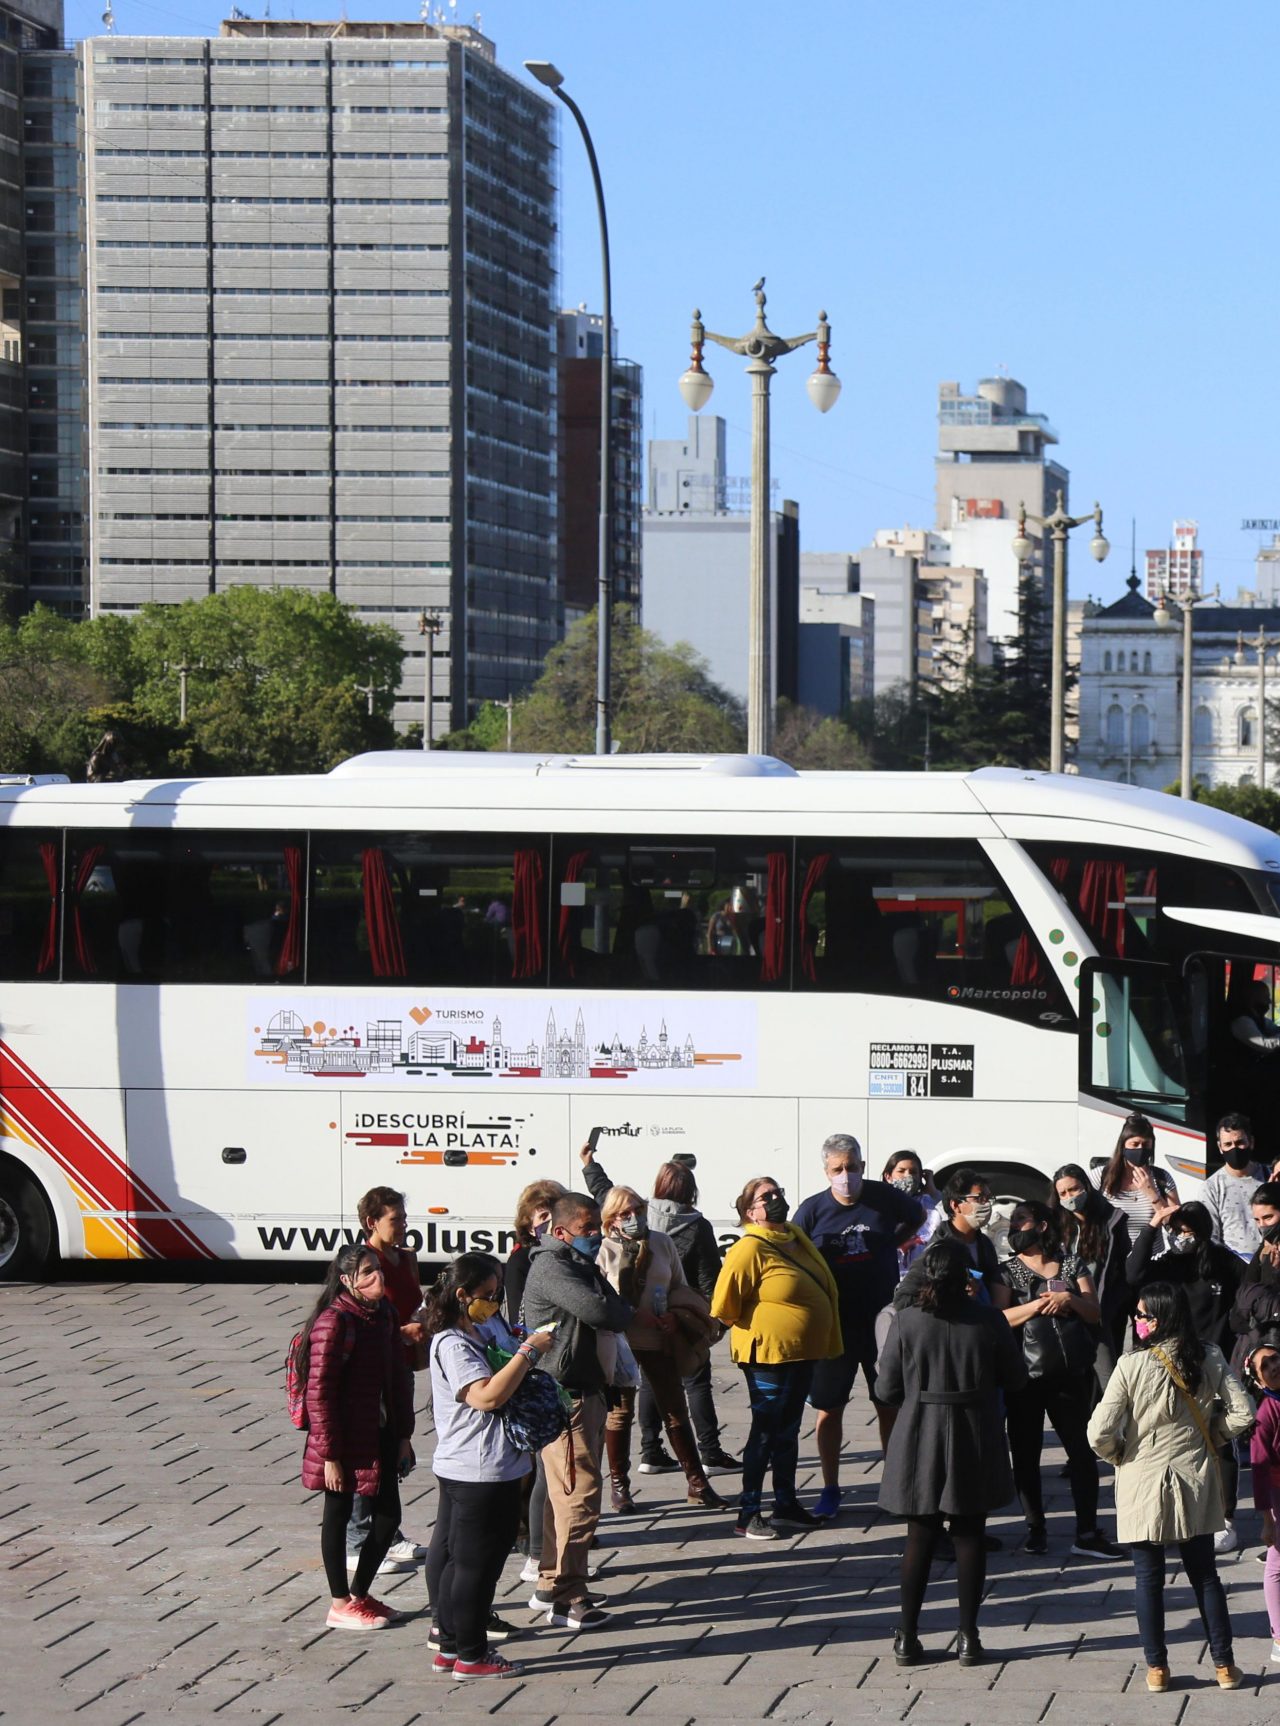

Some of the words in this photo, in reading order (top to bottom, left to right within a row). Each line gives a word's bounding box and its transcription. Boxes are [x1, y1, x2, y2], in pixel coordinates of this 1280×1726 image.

[961, 987, 1048, 1000] Marcopolo
[435, 1010, 484, 1019] TURISMO
[871, 1044, 915, 1052] RECLAMOS
[941, 1047, 962, 1055] T.A.
[871, 1052, 928, 1069] 0800-6662993
[931, 1058, 973, 1071] PLUSMAR
[941, 1075, 961, 1083] S.A.
[910, 1076, 925, 1096] 84
[355, 1111, 465, 1129] ¡DESCUBRÍ
[413, 1132, 439, 1147] LA
[447, 1133, 520, 1148] PLATA!
